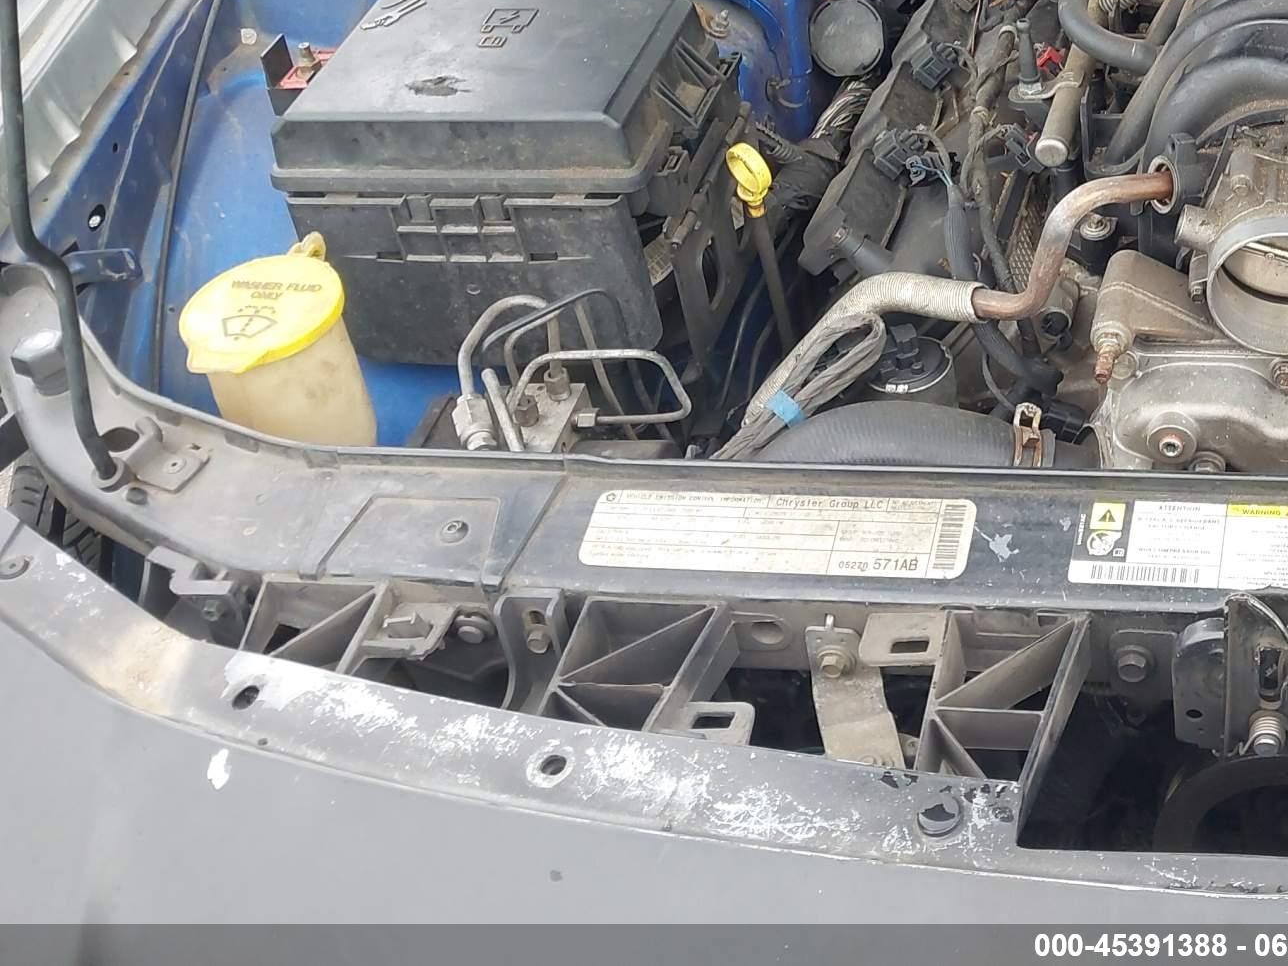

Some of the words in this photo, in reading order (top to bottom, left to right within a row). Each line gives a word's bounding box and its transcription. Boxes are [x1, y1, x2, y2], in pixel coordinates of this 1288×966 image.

[232, 280, 283, 291] WASHER
[286, 282, 322, 293] FLUID
[250, 291, 283, 300] ONLY
[776, 497, 823, 510] Chrysler
[829, 499, 859, 511] Group
[864, 500, 884, 509] LLC
[1242, 508, 1281, 516] WARNING
[873, 558, 919, 571] 571AB
